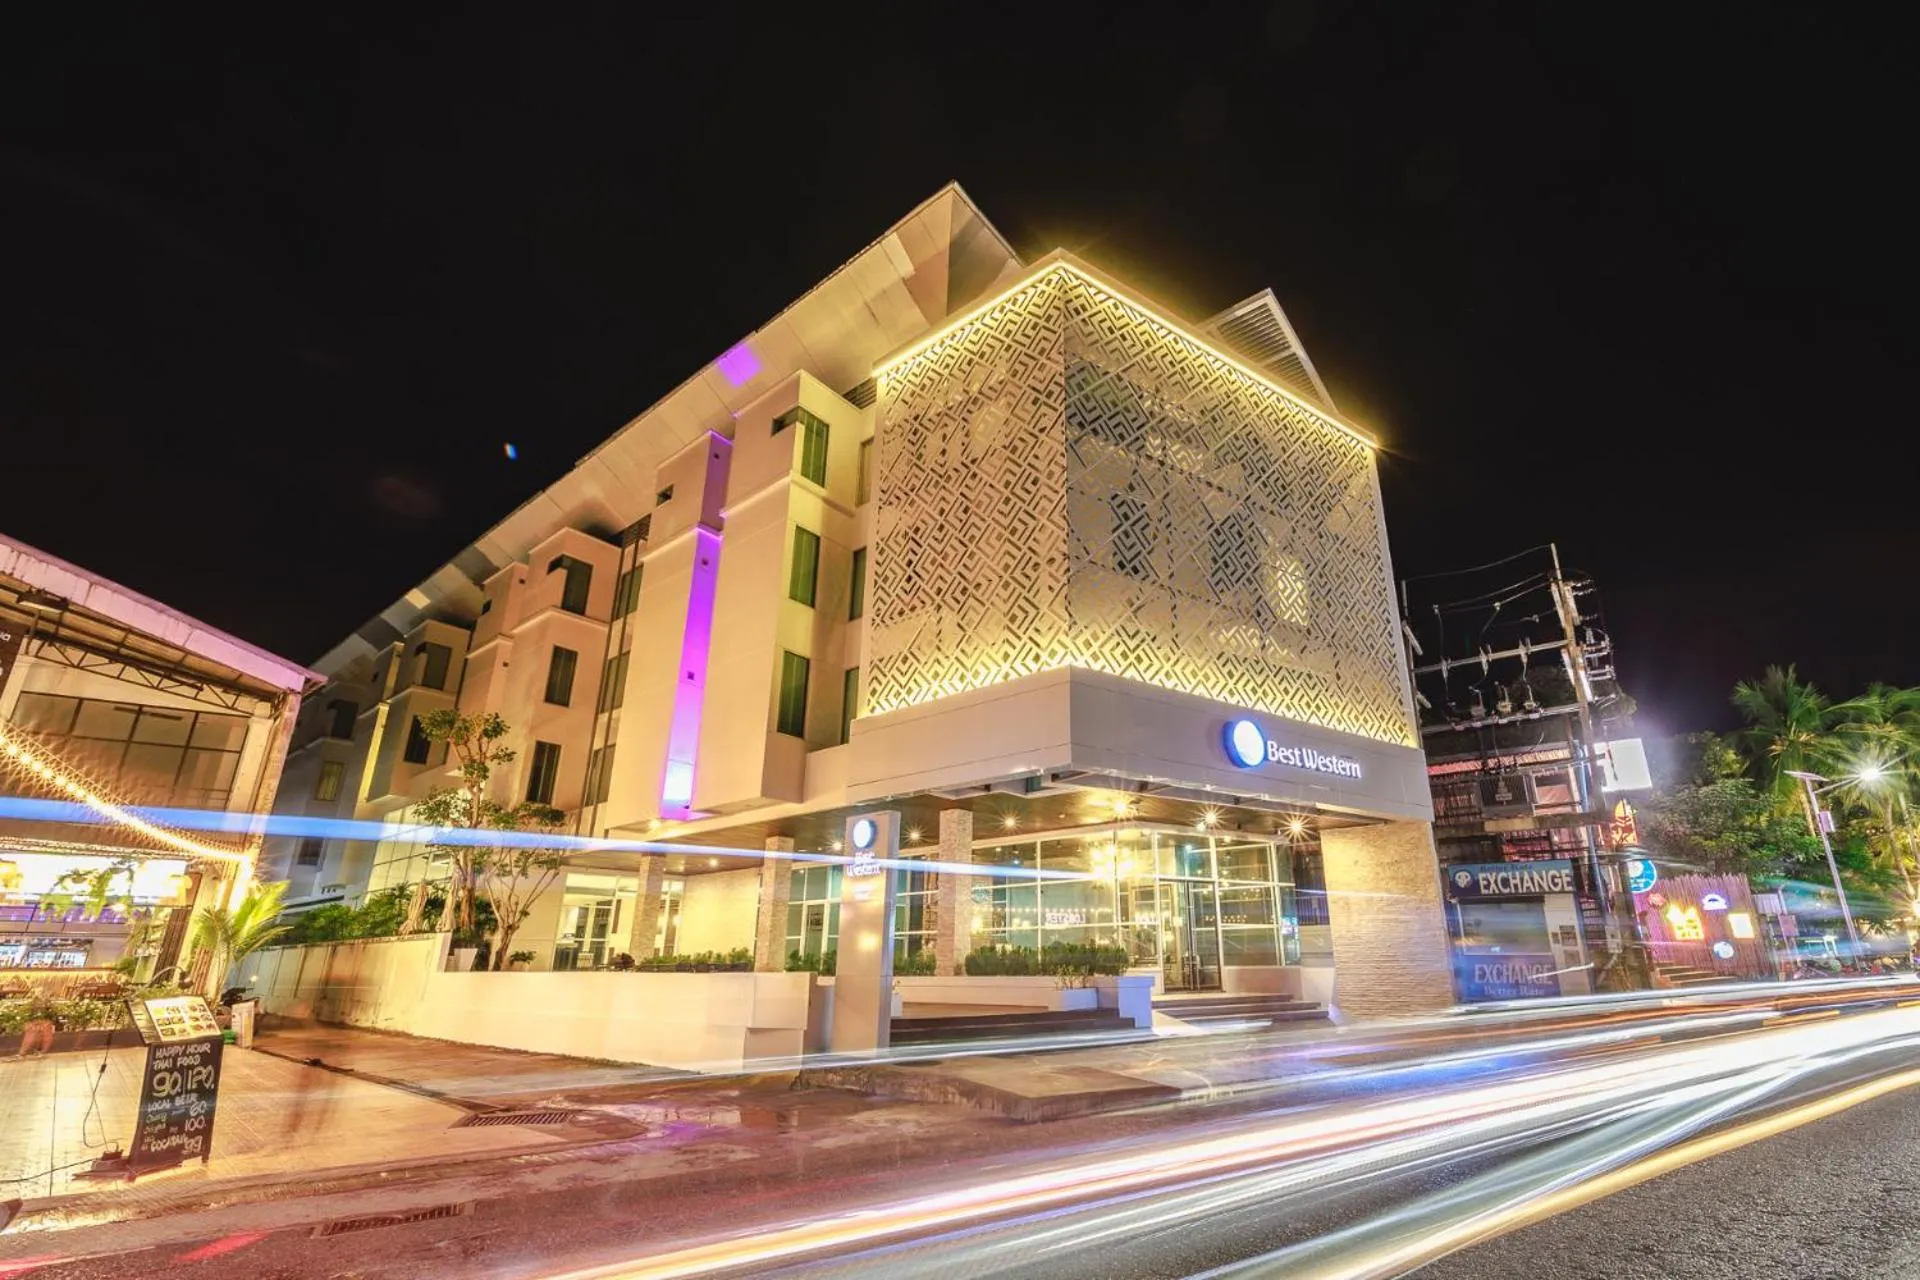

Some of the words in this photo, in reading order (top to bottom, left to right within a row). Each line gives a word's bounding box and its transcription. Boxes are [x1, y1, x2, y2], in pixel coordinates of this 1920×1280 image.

[1267, 740, 1302, 767] Best
[1303, 748, 1362, 778] Western
[1478, 869, 1573, 895] EXCHANGE
[1474, 963, 1553, 985] EXCHANGE
[155, 1044, 186, 1059] HAPPY
[186, 1042, 211, 1054] HOUR
[153, 1058, 173, 1071] THAI
[177, 1054, 201, 1067] FOOD
[147, 1099, 171, 1112] LOCAL
